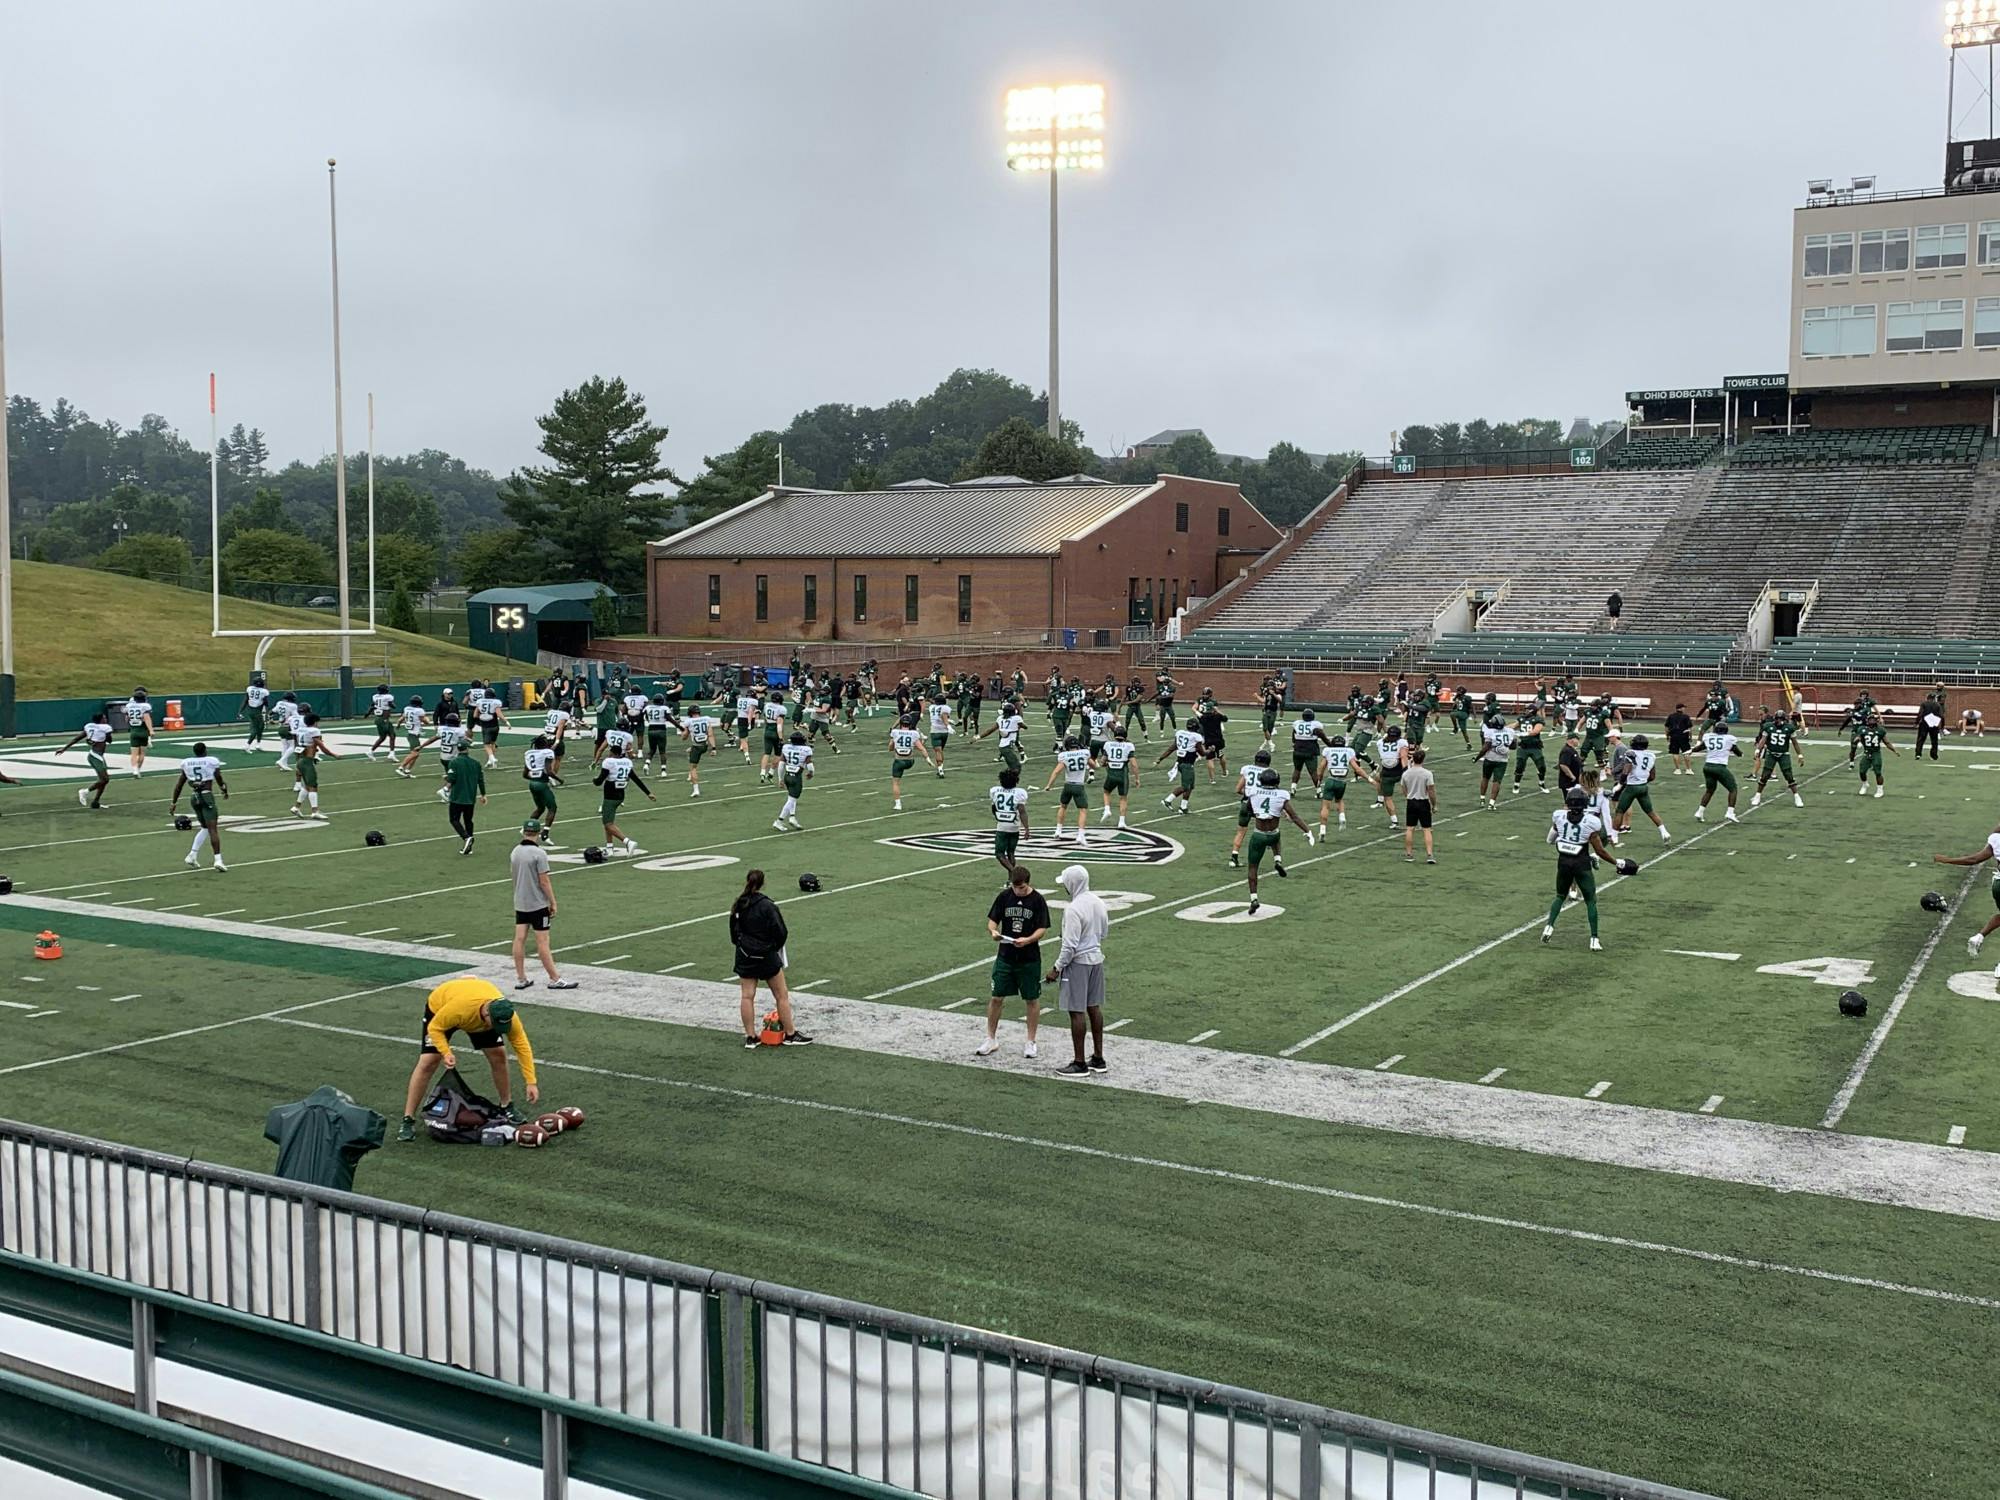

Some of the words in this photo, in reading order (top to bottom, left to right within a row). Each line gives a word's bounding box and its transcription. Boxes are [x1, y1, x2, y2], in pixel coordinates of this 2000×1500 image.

[1726, 377, 1759, 387] TOWER
[1760, 374, 1786, 386] CLUB
[1643, 391, 1668, 399] OHIO
[1669, 389, 1714, 399] BOBCATS
[1575, 456, 1592, 465] 102
[1397, 463, 1412, 472] 101
[496, 607, 525, 629] 25
[129, 709, 141, 720] 22
[1092, 715, 1104, 726] 90
[693, 722, 708, 734] 30
[1298, 724, 1312, 735] 95
[1586, 718, 1599, 729] 66
[441, 731, 454, 744] 27
[896, 735, 912, 747] 48
[1176, 736, 1189, 749] 53
[1495, 734, 1509, 746] 50
[1708, 737, 1724, 750] 55
[1770, 733, 1786, 746] 55
[1864, 735, 1879, 747] 24
[787, 751, 800, 765] 15
[1110, 748, 1123, 759] 18
[1330, 753, 1348, 767] 34
[529, 755, 536, 769] 2
[1067, 757, 1085, 771] 26
[1641, 756, 1649, 770] 9
[192, 766, 203, 781] 5
[997, 793, 1015, 811] 24
[1260, 796, 1271, 814] 4
[1562, 822, 1582, 842] 13
[632, 854, 741, 872] 0
[1174, 900, 1286, 924] 0
[1756, 956, 1878, 988] 4
